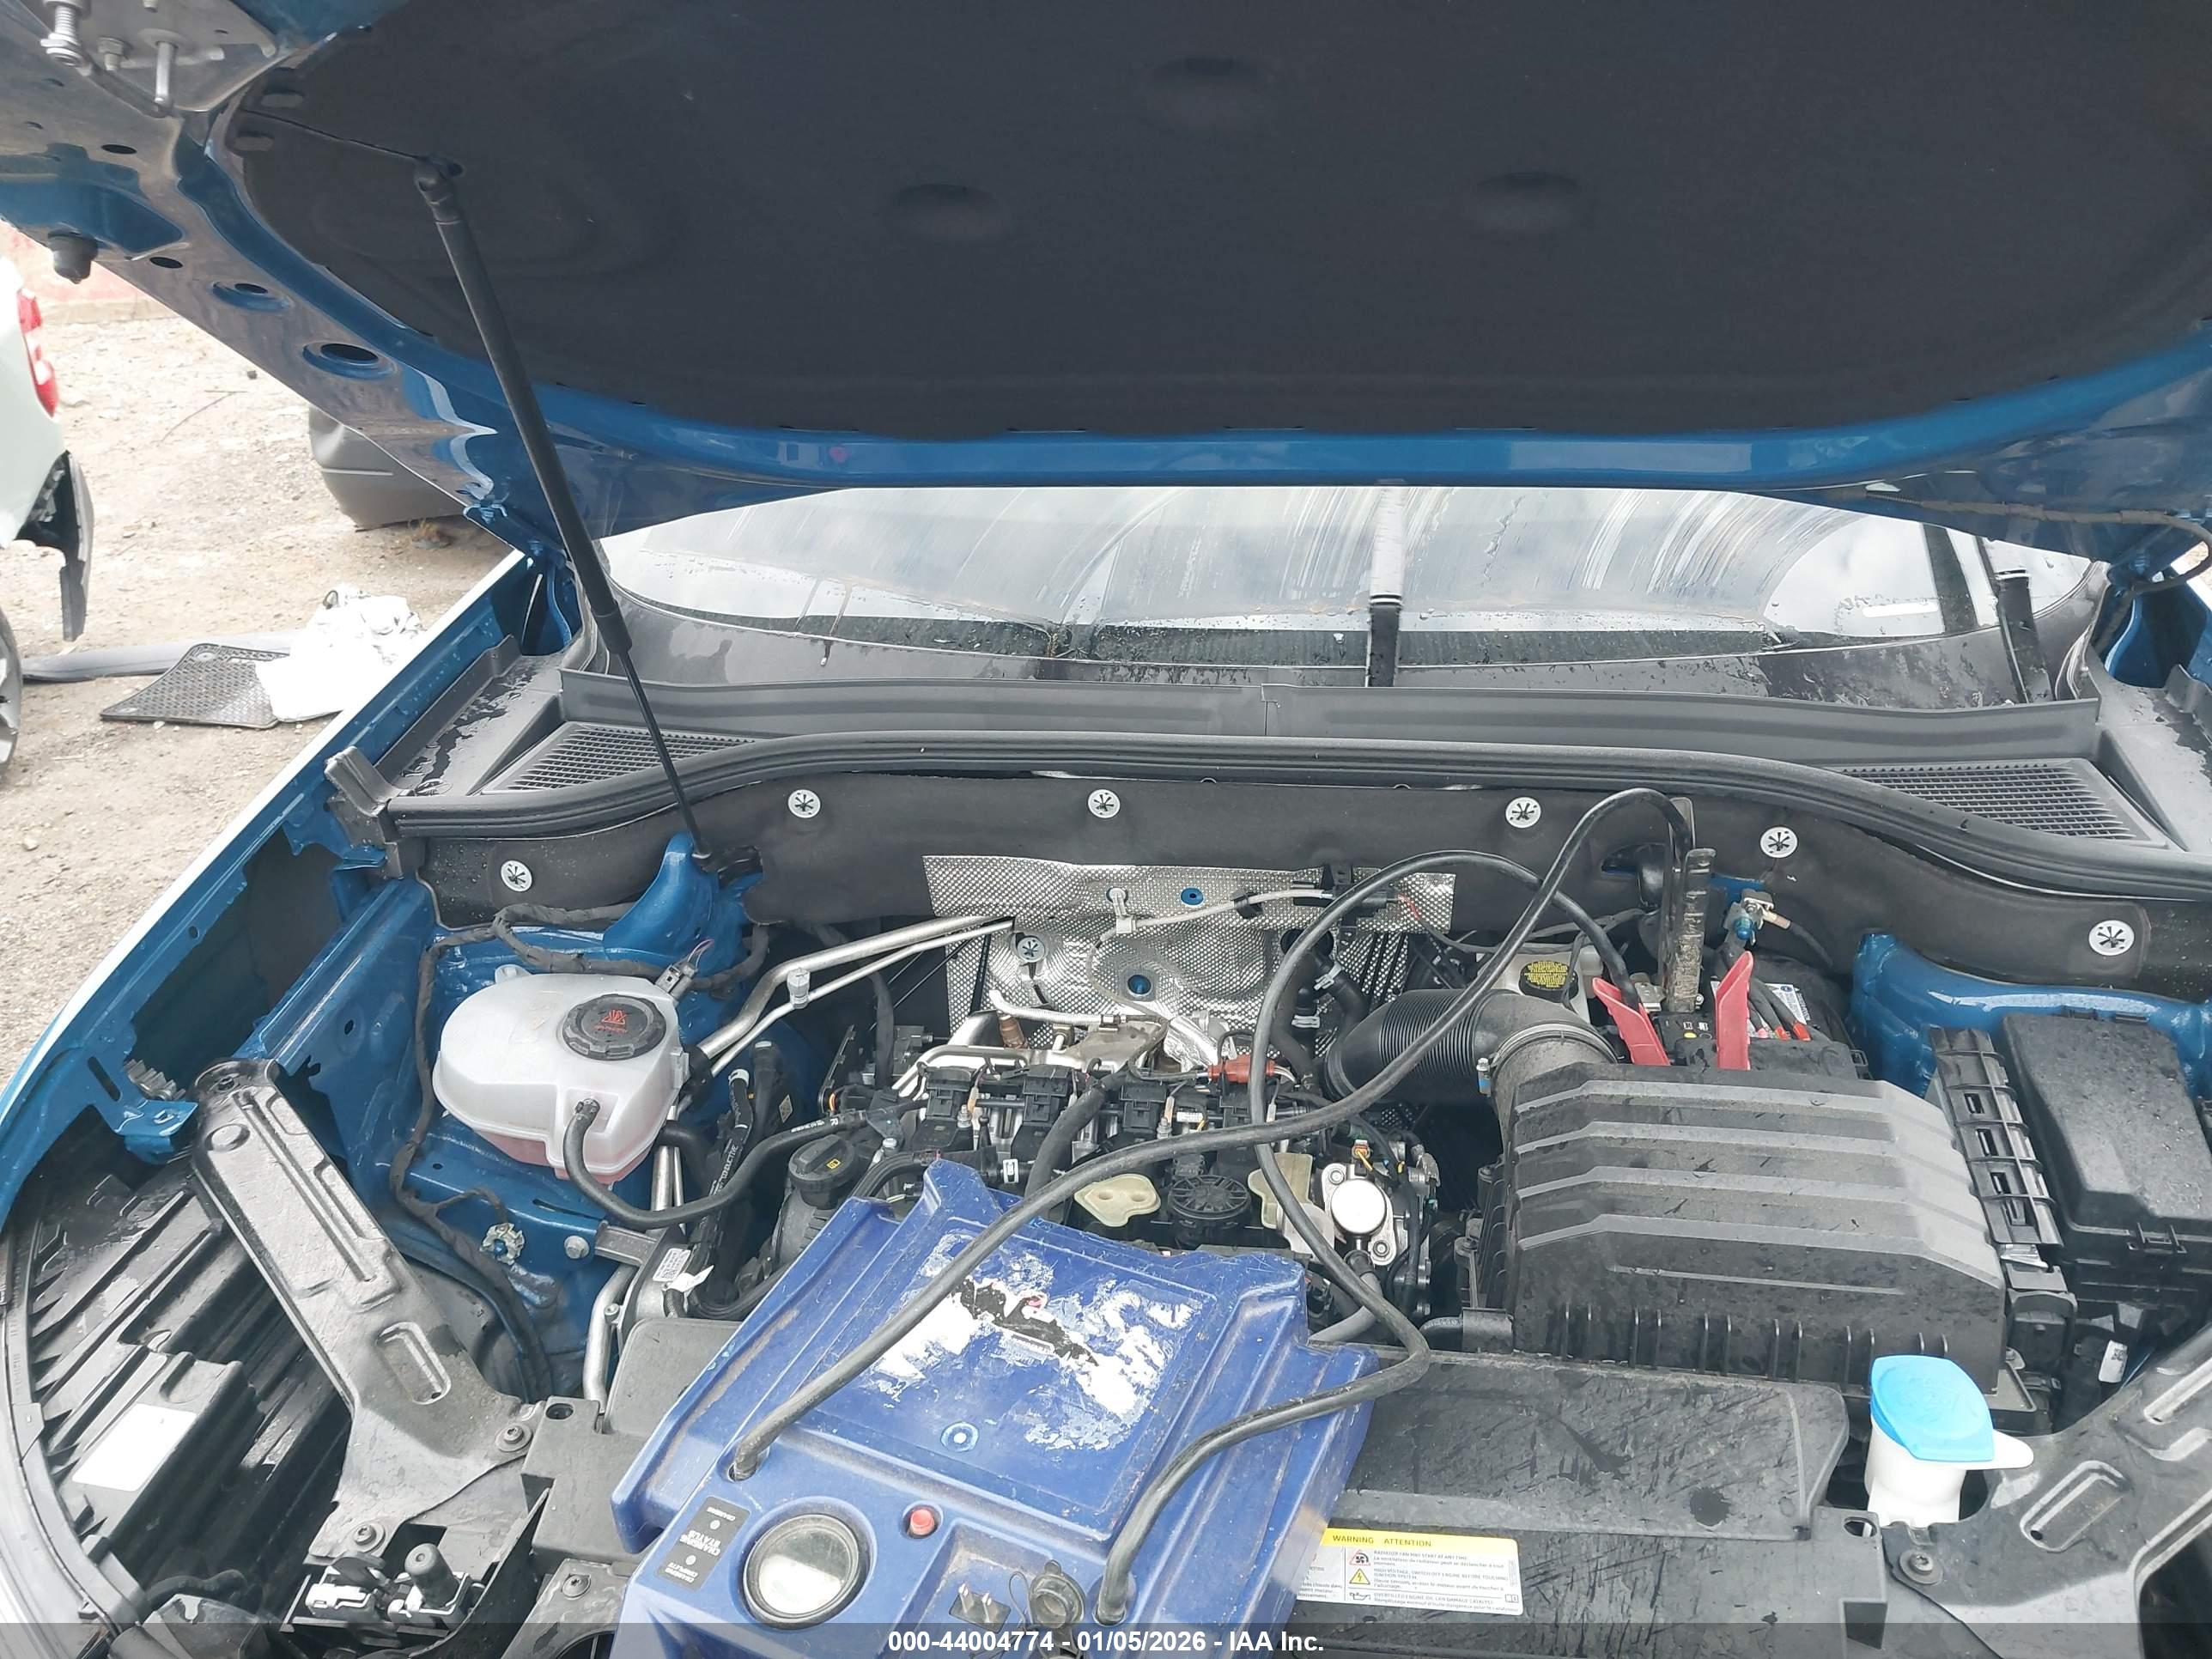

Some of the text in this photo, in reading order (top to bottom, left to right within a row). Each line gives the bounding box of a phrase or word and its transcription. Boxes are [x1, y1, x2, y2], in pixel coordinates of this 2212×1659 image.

[679, 1534, 721, 1556] CHARGING
[688, 1529, 721, 1548] STATUS
[1333, 1534, 1431, 1547] WARNING ATTENTION
